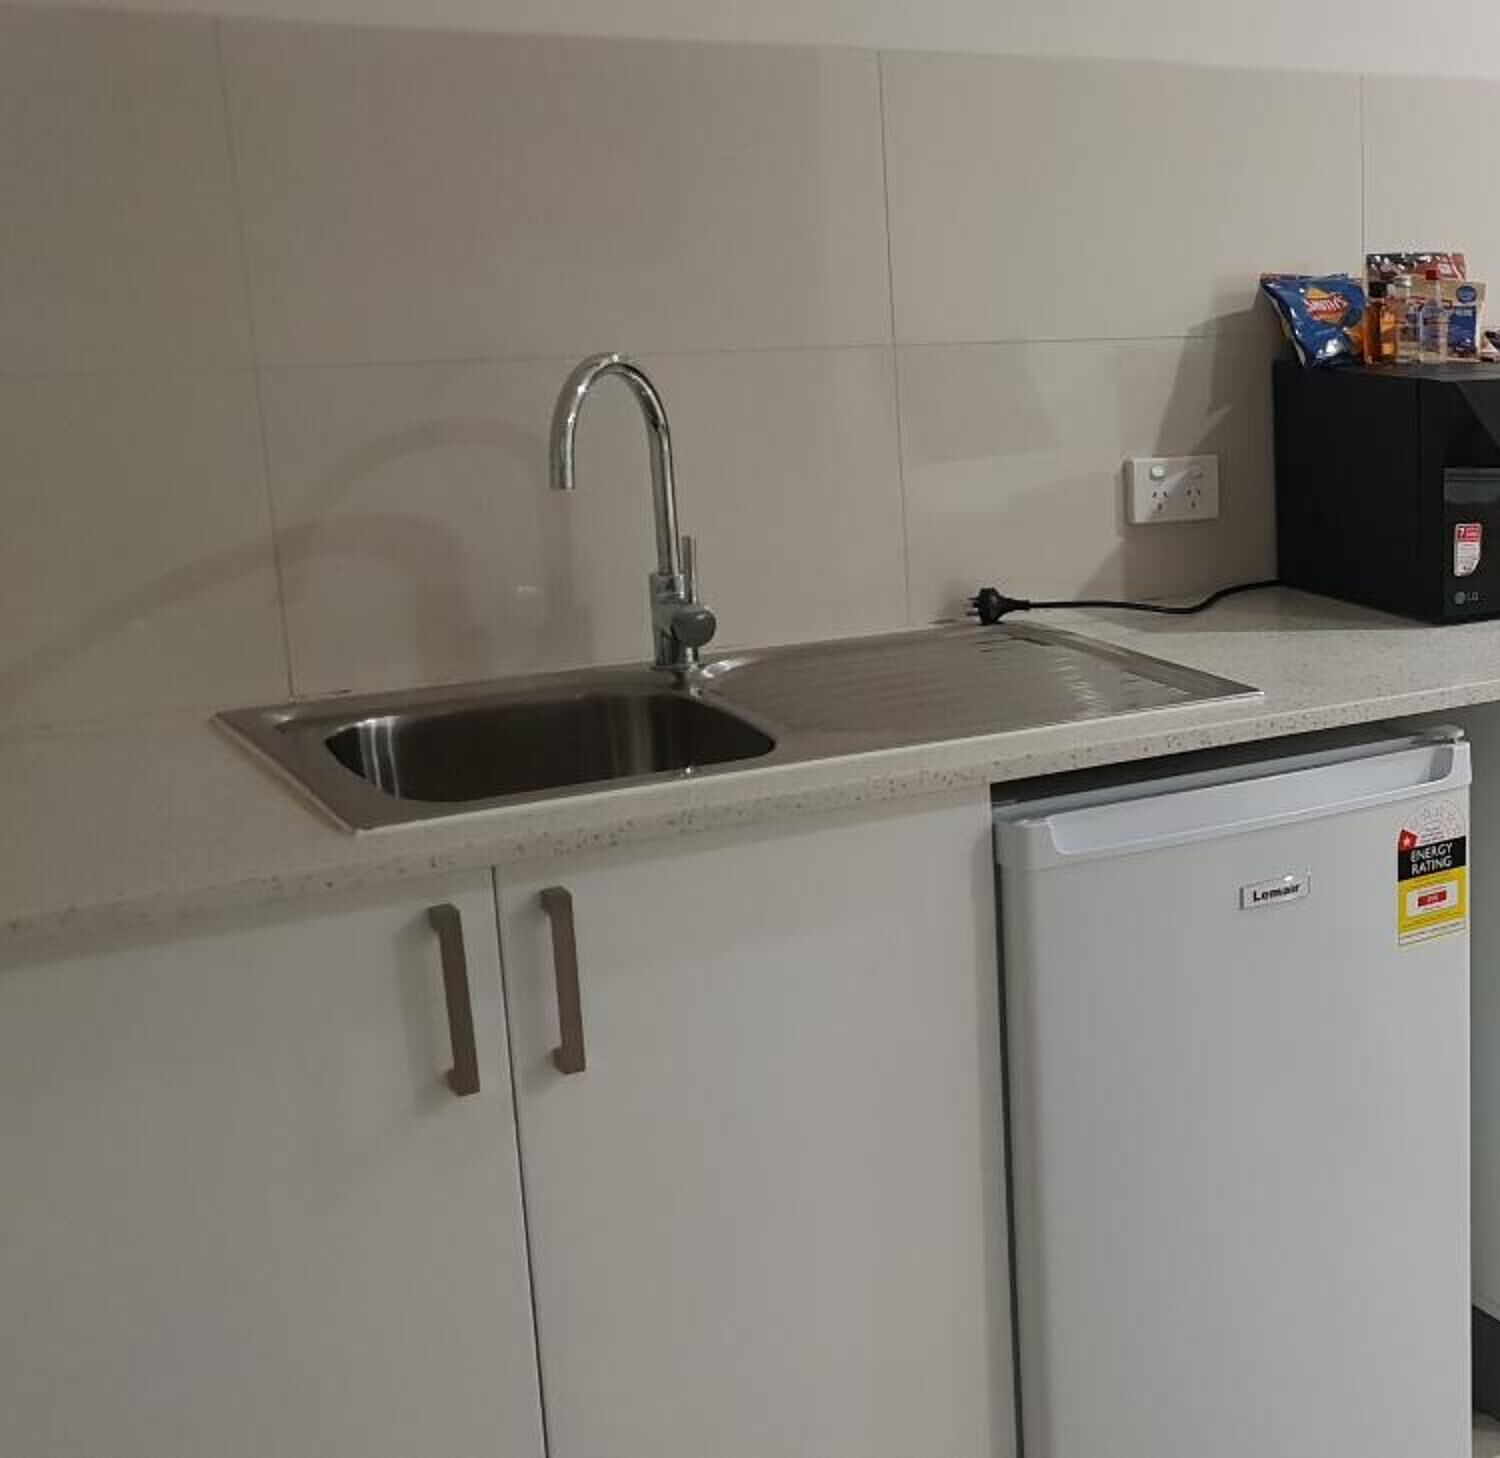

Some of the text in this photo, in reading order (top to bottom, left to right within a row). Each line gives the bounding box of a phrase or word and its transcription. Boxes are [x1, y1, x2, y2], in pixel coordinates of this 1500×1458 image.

[1410, 842, 1453, 863] ENERGY
[1411, 855, 1453, 876] RATING
[1253, 883, 1301, 903] Lemair
